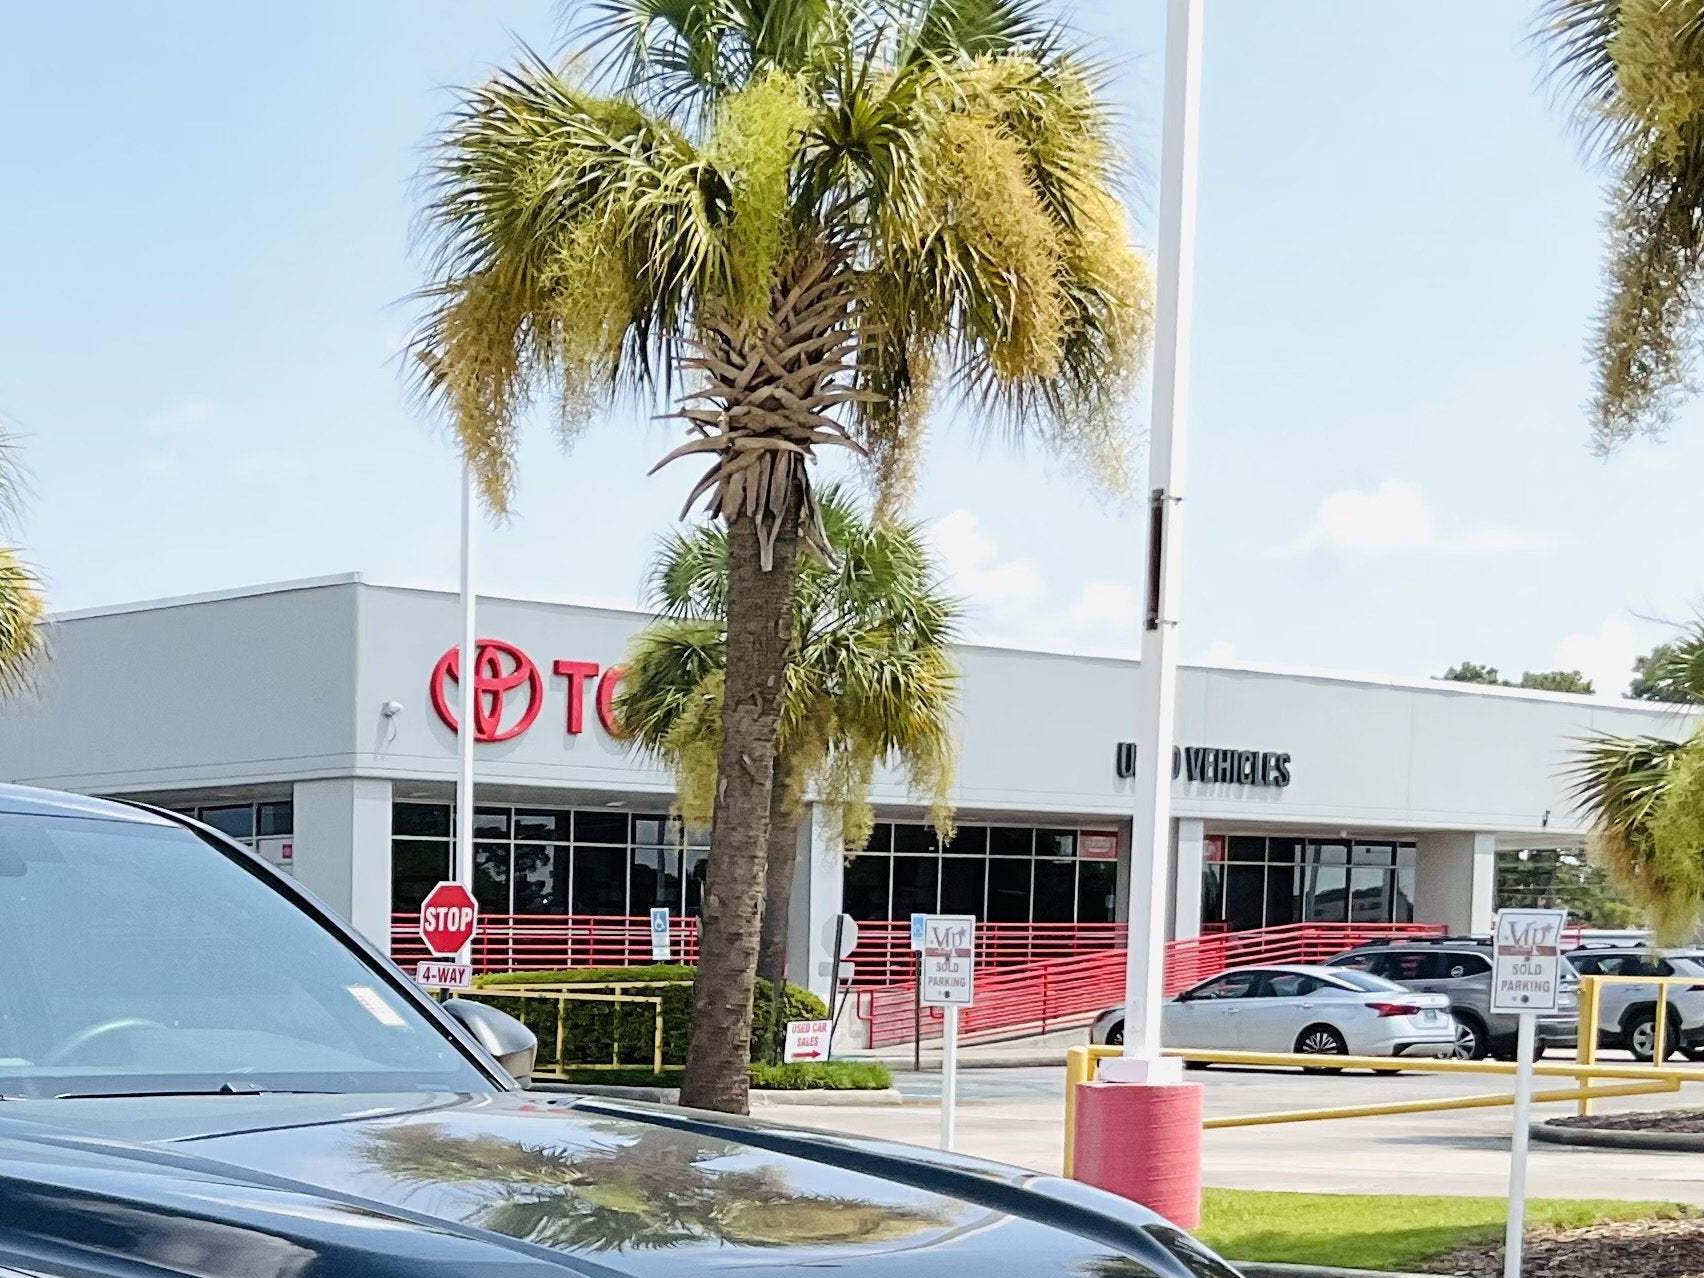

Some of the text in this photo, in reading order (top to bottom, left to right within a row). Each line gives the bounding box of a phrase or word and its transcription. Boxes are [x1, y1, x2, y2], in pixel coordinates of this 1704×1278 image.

[1184, 746, 1291, 787] VEHICLES
[424, 906, 473, 932] STOP
[935, 961, 959, 973] SOLD
[1511, 963, 1542, 976] SOLD
[422, 966, 466, 984] 4-WAY
[927, 976, 966, 988] PARKING
[1500, 980, 1550, 992] PARKING
[792, 1022, 827, 1033] USED CAR
[797, 1036, 819, 1047] SALES
